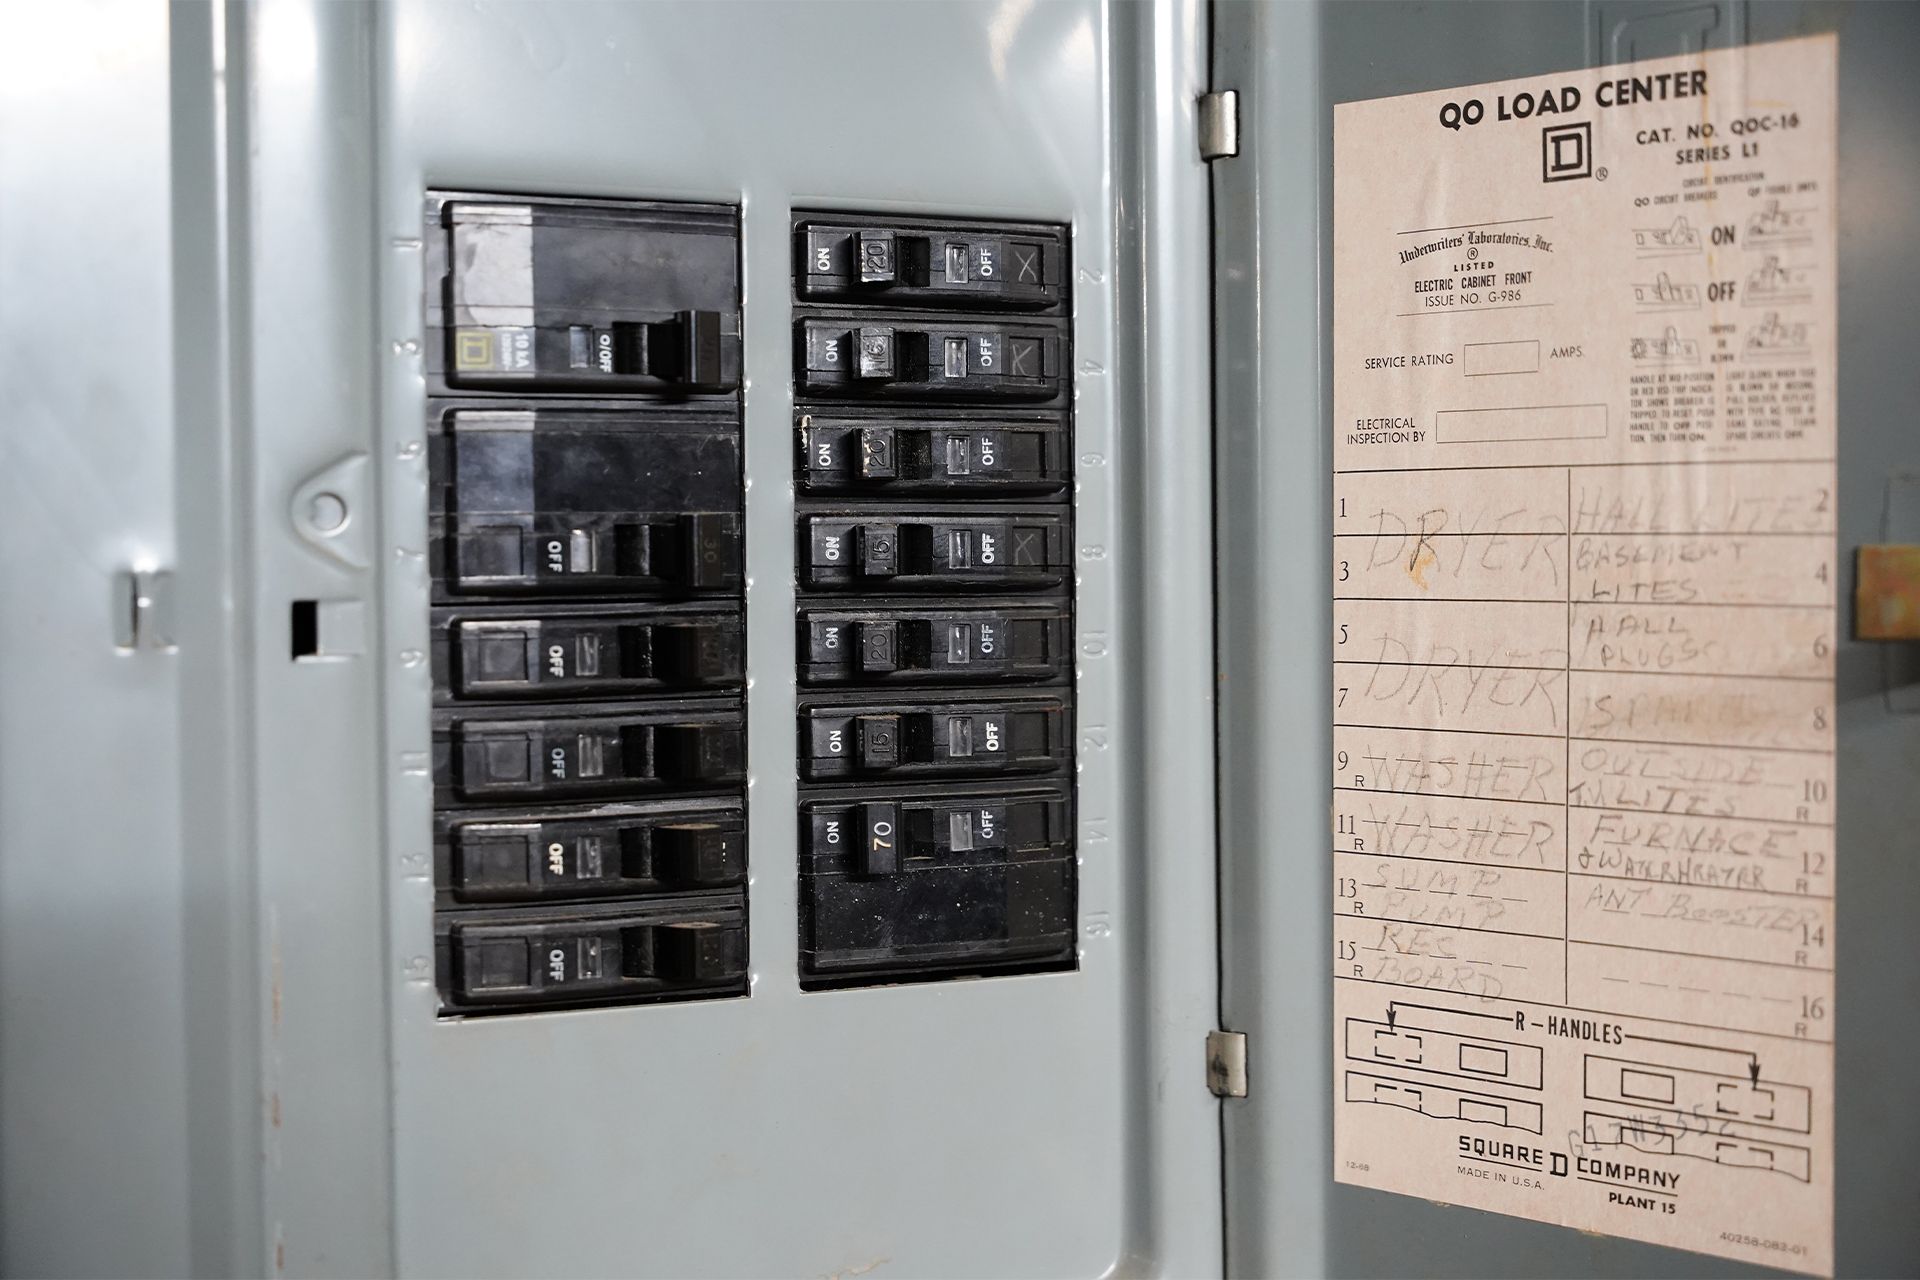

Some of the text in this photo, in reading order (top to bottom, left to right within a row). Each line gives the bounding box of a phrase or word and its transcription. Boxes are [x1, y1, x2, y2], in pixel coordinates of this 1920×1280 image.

[1439, 70, 1708, 132] QO LOAD CENTER
[1636, 114, 1800, 145] CAT. NO. QOC-16
[1675, 146, 1730, 165] SERIES
[1711, 225, 1736, 245] ON
[818, 247, 831, 271] ON
[866, 242, 885, 271] 20
[1399, 232, 1465, 265] Underwriters'
[1532, 234, 1553, 253] Inc.
[980, 247, 993, 277] OFF
[1453, 261, 1495, 272] LISTED
[1414, 271, 1533, 293] ELECTRIC CABINET FRONT
[1707, 281, 1736, 301] OFF
[1425, 290, 1522, 307] ISSUE NO. G-986
[826, 339, 838, 362] ON
[980, 338, 993, 367] OFF
[1365, 356, 1406, 370] SERVICE
[1411, 353, 1454, 367] RATING
[1356, 417, 1416, 431] ELECTRICAL
[1347, 431, 1426, 445] INSPECTION BY
[819, 444, 832, 467] ON
[869, 438, 886, 467] 20
[982, 437, 994, 466] OFF
[1339, 497, 1347, 518] 1
[1815, 489, 1829, 512] 2
[547, 541, 562, 572] OFF
[825, 536, 840, 561] ON
[872, 538, 890, 561] 15
[981, 533, 996, 564] OFF
[1366, 507, 1567, 587] DRYER
[1339, 561, 1349, 581] 3
[1814, 562, 1828, 584] 4
[1592, 578, 1699, 602] LITES
[826, 627, 839, 650] ON
[981, 623, 995, 653] OFF
[1338, 625, 1348, 644] 5
[1587, 615, 1688, 648] HALL
[870, 634, 888, 661] 20
[1812, 634, 1828, 658] 6
[549, 645, 564, 677] OFF
[1364, 632, 1571, 729] DRYER
[1338, 688, 1349, 708] 7
[1812, 705, 1827, 730] 8
[828, 729, 842, 753] ON
[871, 730, 890, 754] 15
[985, 721, 999, 751] OFF
[551, 748, 566, 779] OFF
[1337, 750, 1349, 771] 9
[1367, 744, 1554, 801] WASHER
[1581, 747, 1775, 784] OUTSIDE
[1355, 775, 1365, 787] R
[1803, 779, 1827, 802] 10
[1616, 785, 1736, 817] LITES
[980, 809, 994, 839] OFF
[1338, 814, 1356, 834] 11
[1796, 806, 1809, 821] R
[827, 820, 840, 844] ON
[873, 820, 893, 852] 70
[1368, 802, 1554, 865] WASHER
[1590, 814, 1797, 859] FURNACE
[1354, 838, 1364, 851] R
[548, 843, 564, 876] OFF
[1802, 852, 1825, 876] 12
[1338, 877, 1356, 898] 13
[1376, 863, 1501, 899] SUMP
[1796, 879, 1809, 892] R
[1353, 901, 1364, 914] R
[1379, 890, 1506, 932] PUMP
[1584, 883, 1820, 930] ANT BOOSTER
[1801, 923, 1825, 948] 14
[1338, 940, 1356, 961] 15
[1795, 951, 1808, 964] R
[549, 949, 565, 981] OFF
[1353, 965, 1364, 977] R
[1373, 956, 1503, 1004] BOARD
[1801, 995, 1825, 1020] 16
[1794, 1023, 1808, 1036] R
[1458, 1135, 1681, 1190] SQUARE D COMPANY
[1457, 1165, 1545, 1192] MADE IN U.S.A.
[1608, 1192, 1676, 1216] PLANT 15
